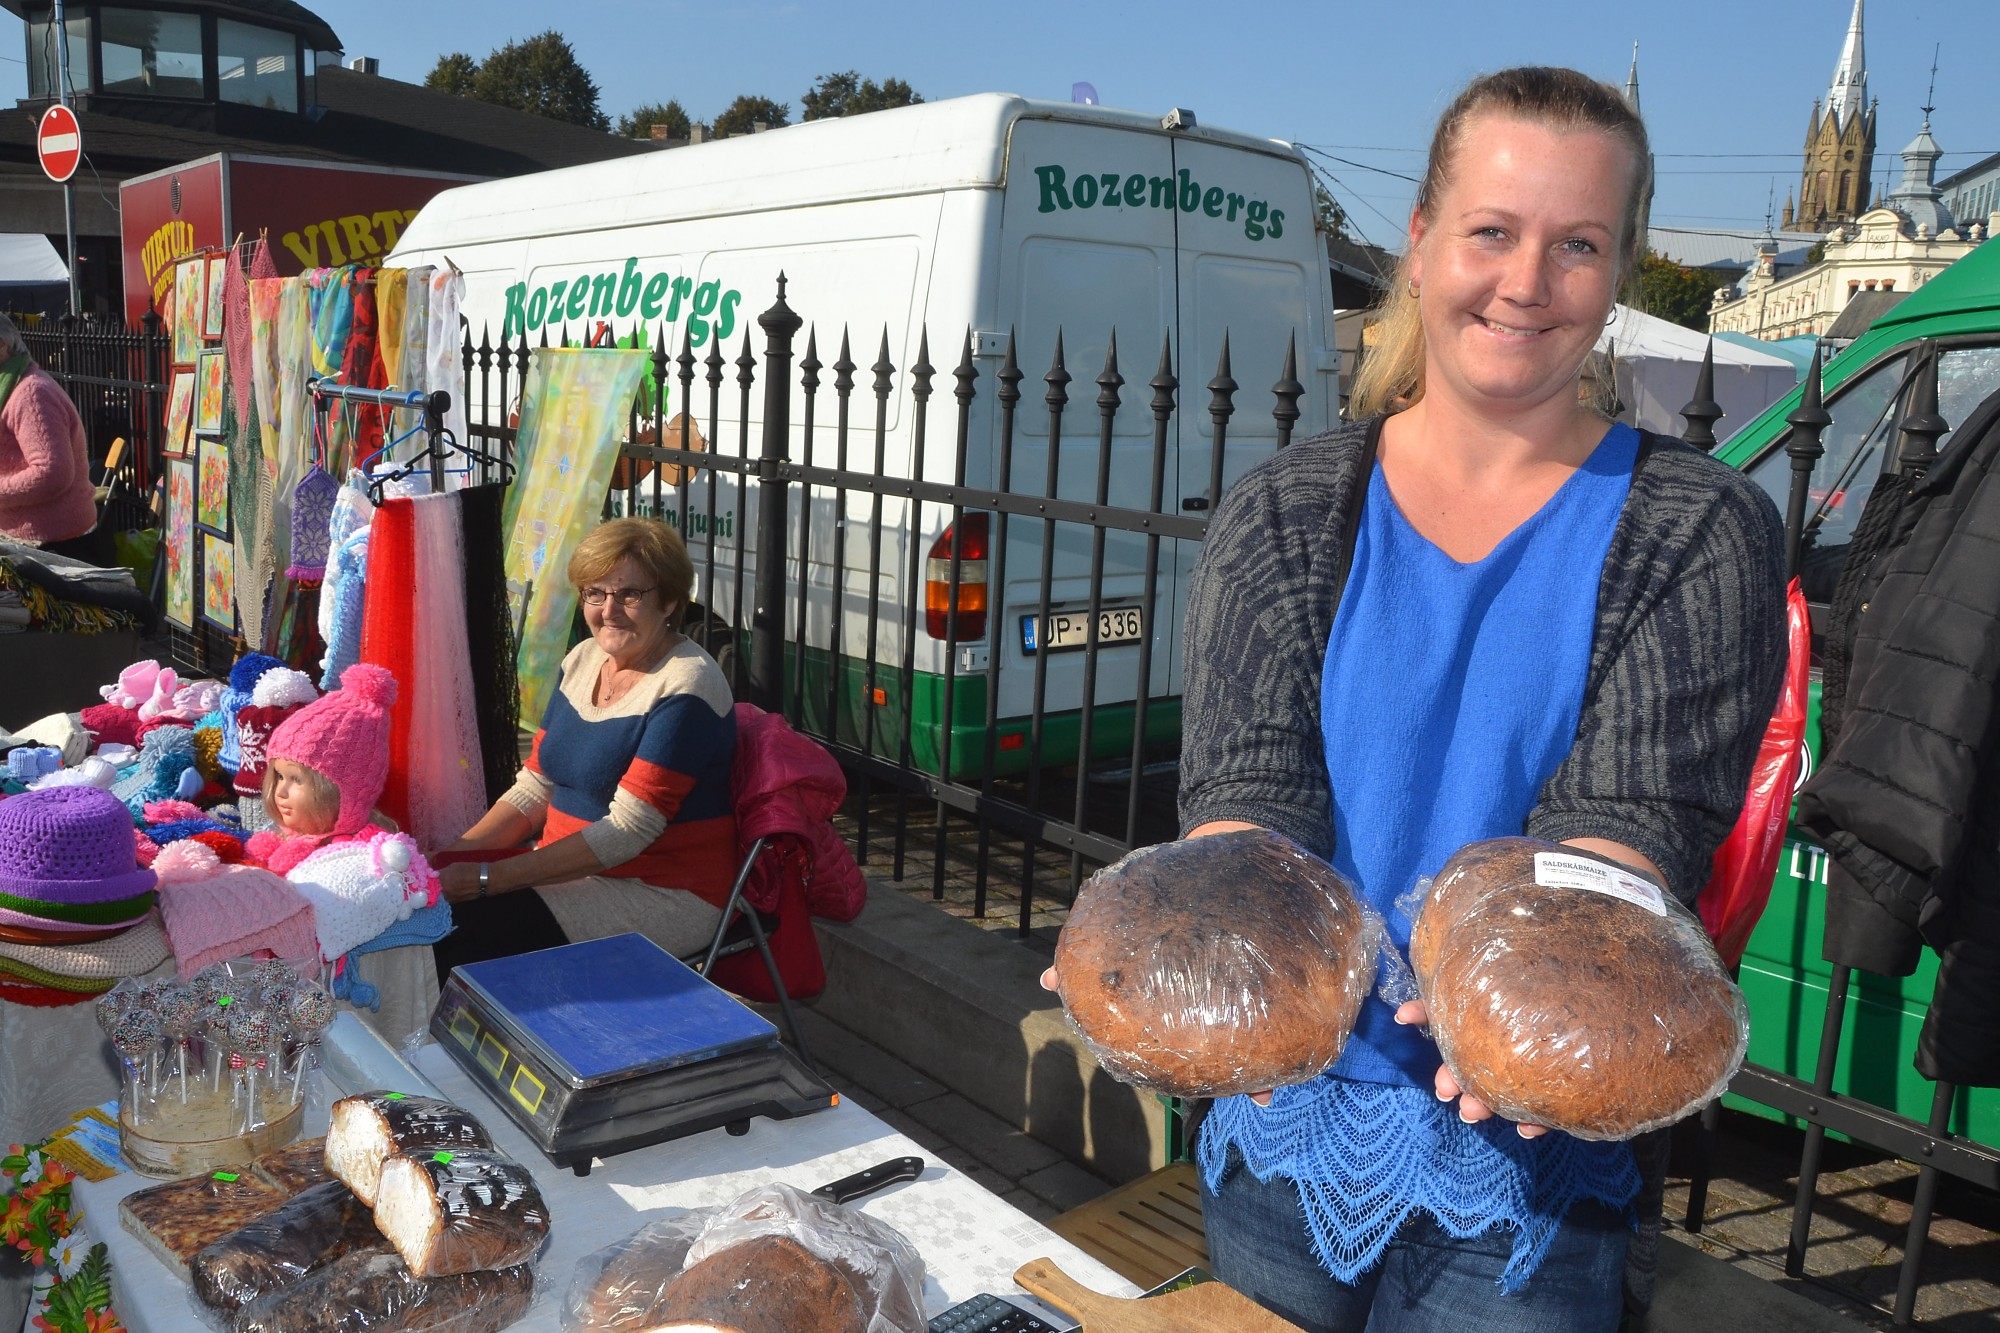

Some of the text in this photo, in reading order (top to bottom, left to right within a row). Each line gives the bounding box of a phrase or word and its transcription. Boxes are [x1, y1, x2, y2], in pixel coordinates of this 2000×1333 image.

[1034, 165, 1285, 241] Rozenbergs
[506, 257, 741, 348] Rozenbergs
[1024, 636, 1034, 645] LV
